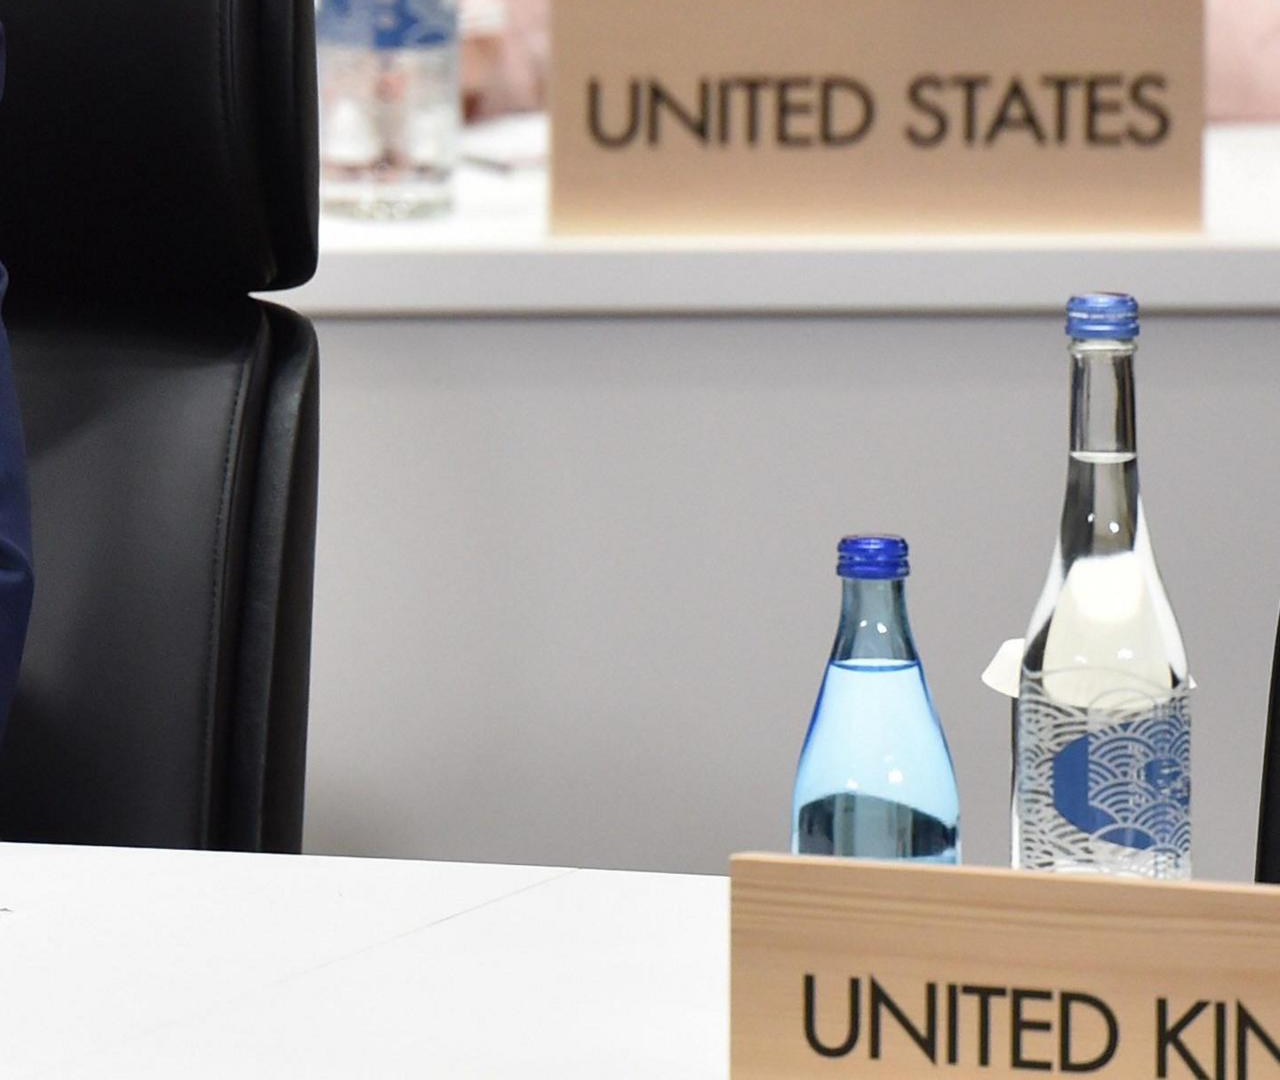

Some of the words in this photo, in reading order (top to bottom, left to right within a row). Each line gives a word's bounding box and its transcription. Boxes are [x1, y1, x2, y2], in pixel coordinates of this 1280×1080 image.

[586, 75, 876, 149] UNITED
[906, 74, 1171, 148] STATES
[803, 974, 1119, 1073] UNITED
